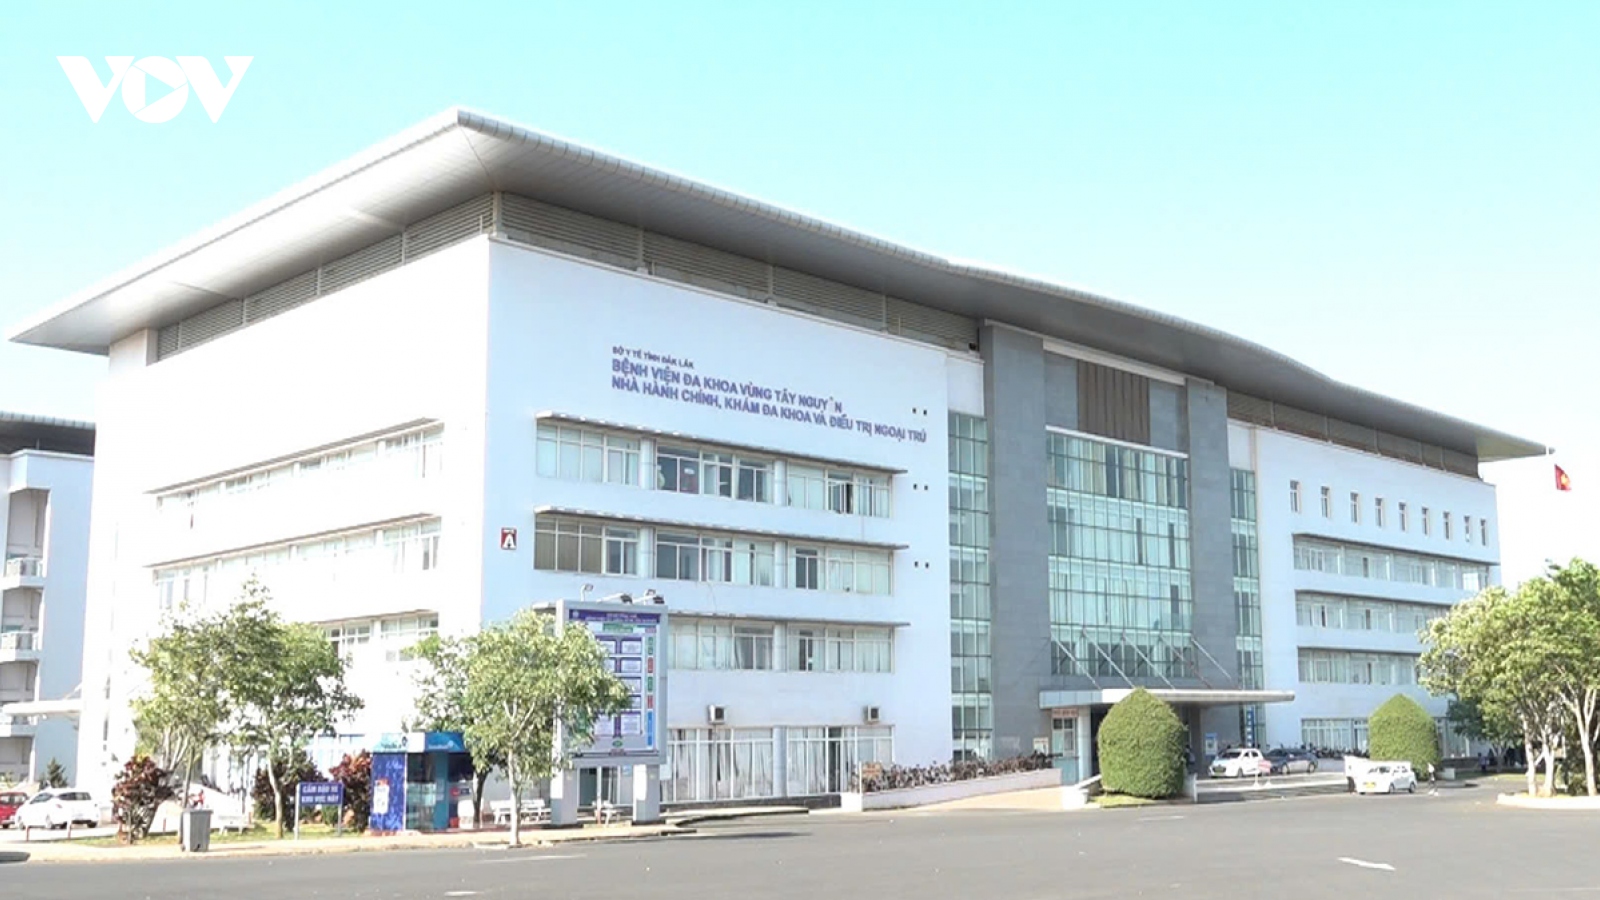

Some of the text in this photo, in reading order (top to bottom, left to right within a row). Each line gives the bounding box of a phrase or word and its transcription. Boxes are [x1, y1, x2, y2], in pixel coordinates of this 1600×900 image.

[612, 357, 648, 378] BỆNH
[651, 365, 681, 386] VIỆN
[683, 373, 701, 388] ĐA
[703, 376, 738, 395] KHOA
[739, 380, 773, 401] VÙNG
[611, 375, 640, 393] NHÀ
[643, 379, 679, 400] HÀNH
[681, 388, 722, 409] CHÍNH,
[724, 396, 760, 415] KHÁM
[762, 403, 779, 418] ĐA
[780, 406, 813, 423] KHOA
[812, 409, 828, 426] VÀ
[855, 420, 873, 438] TRỊ
[874, 423, 906, 443] NGOẠI
